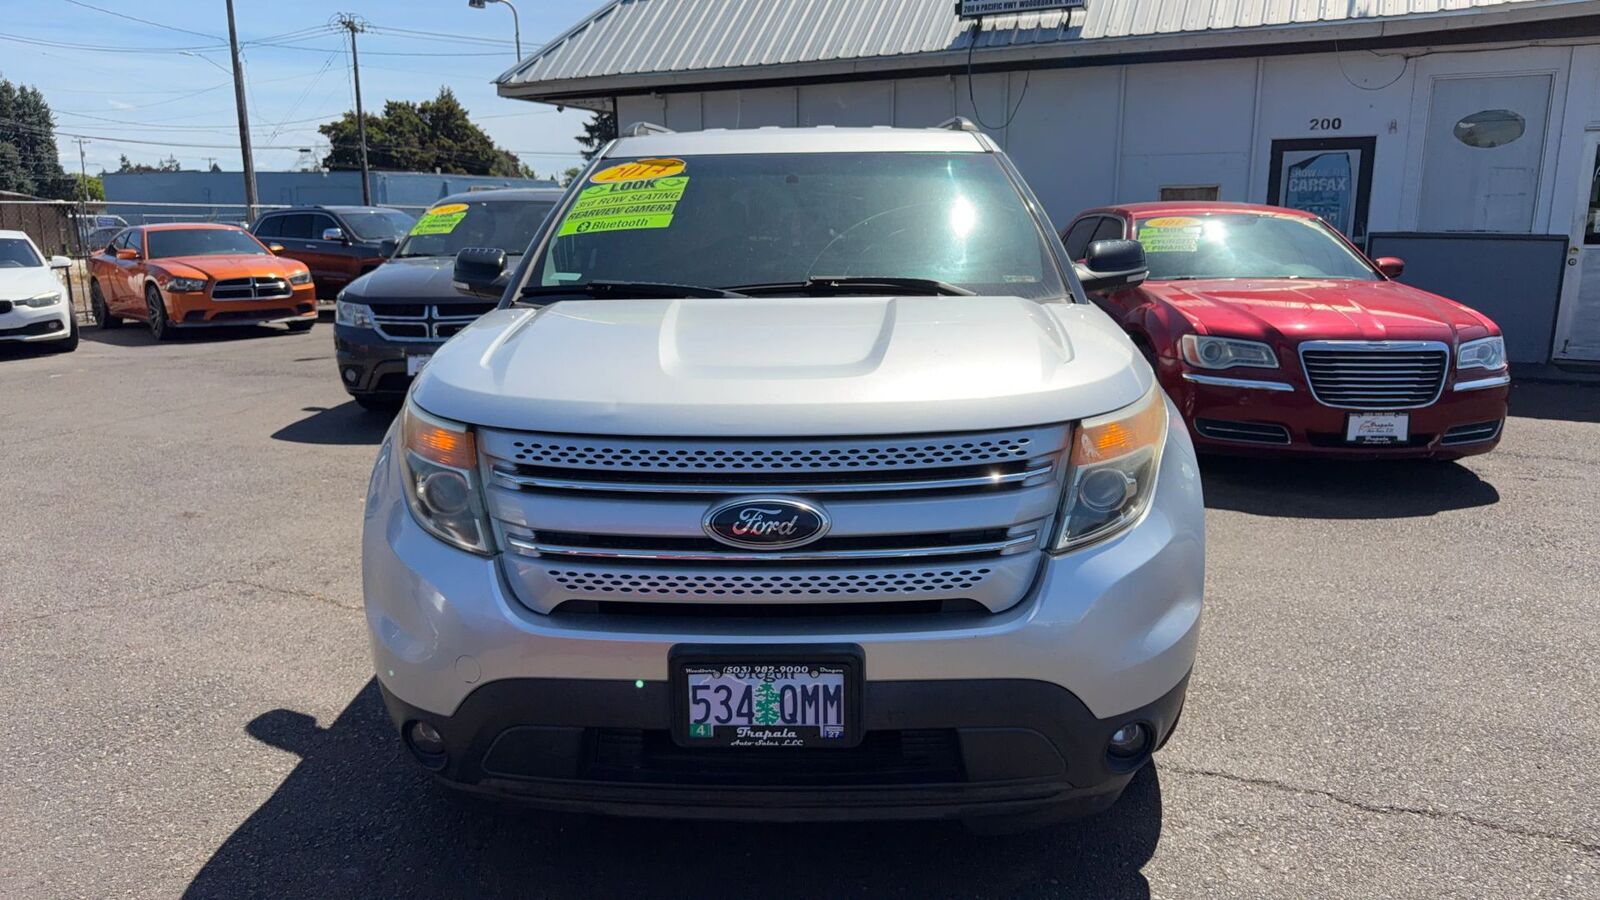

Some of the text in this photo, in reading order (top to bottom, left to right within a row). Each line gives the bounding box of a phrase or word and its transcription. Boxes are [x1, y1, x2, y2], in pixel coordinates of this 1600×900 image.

[981, 3, 1003, 12] PACIFIC
[1003, 2, 1017, 10] HWY
[1310, 118, 1342, 131] 200
[609, 179, 657, 193] LOOK
[1288, 177, 1347, 192] CARFAX
[599, 195, 626, 206] ROW
[630, 191, 680, 202] SEATING
[567, 203, 672, 221] REARVIEW CAMERA
[591, 218, 649, 230] Bluetooth
[731, 507, 799, 535] Ford
[722, 666, 751, 674] (503)
[754, 665, 809, 674] 982-9000
[691, 684, 842, 725] 534 QMM
[696, 725, 706, 736] 4
[736, 726, 797, 740] Trapala
